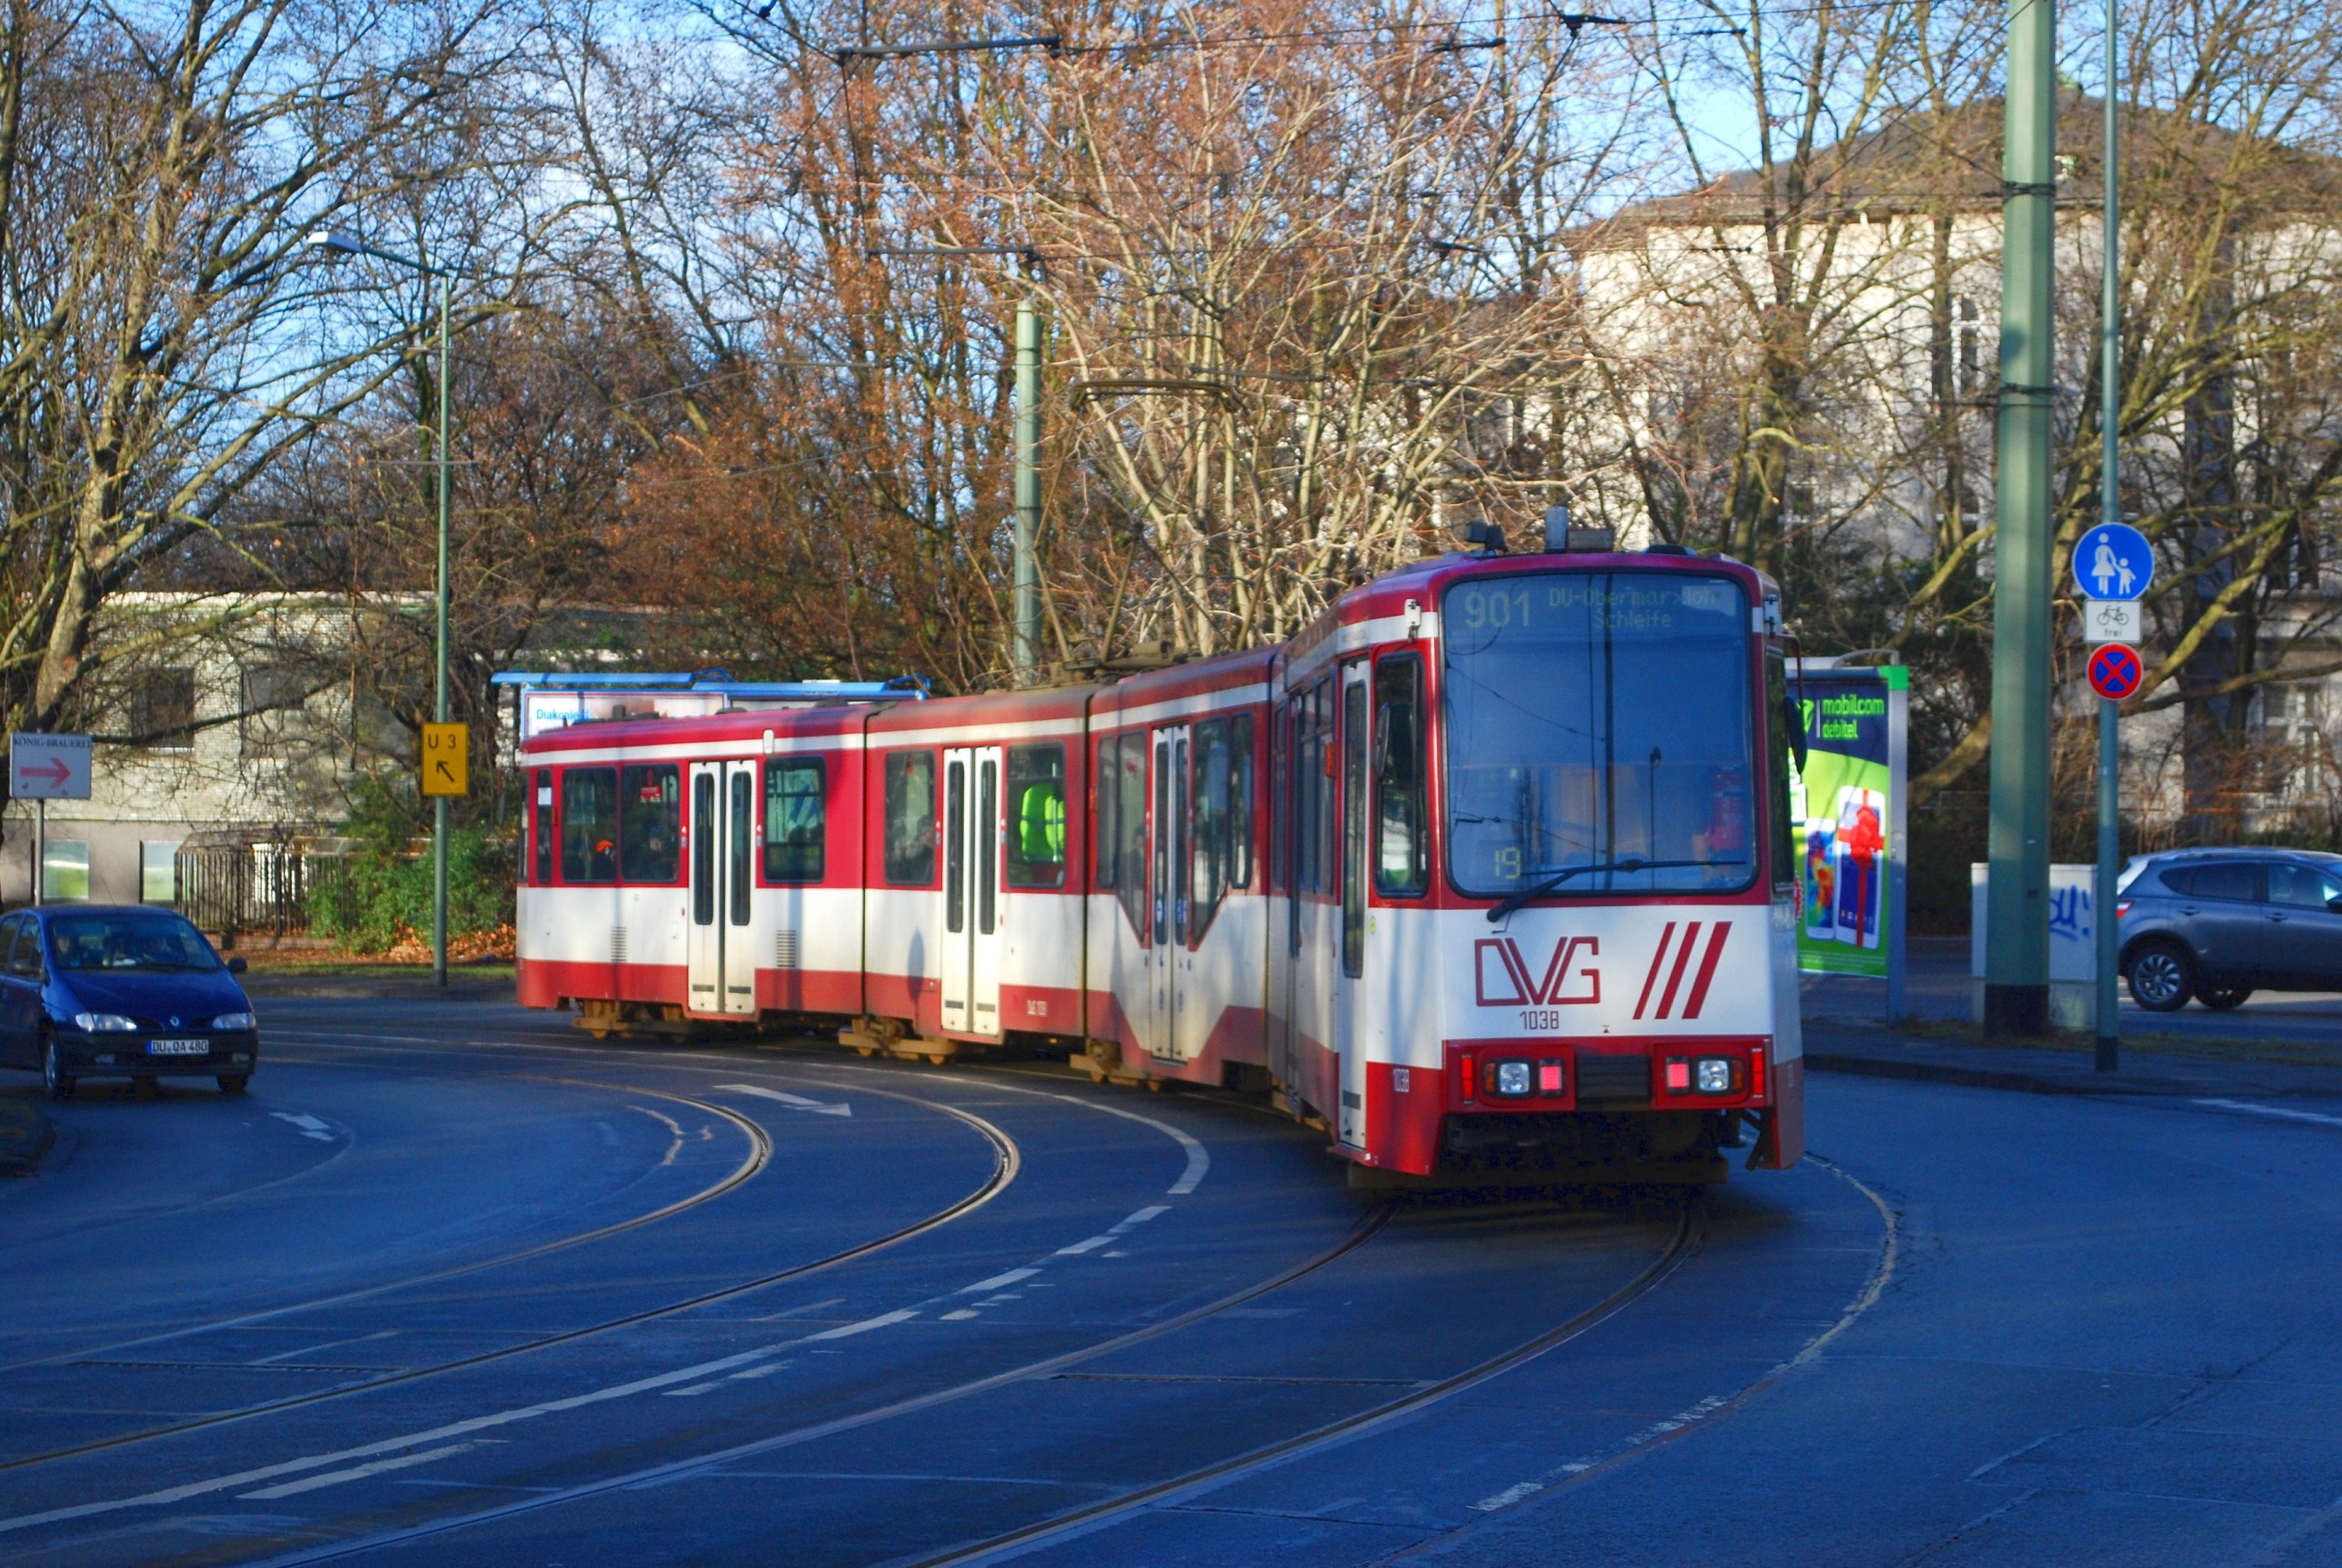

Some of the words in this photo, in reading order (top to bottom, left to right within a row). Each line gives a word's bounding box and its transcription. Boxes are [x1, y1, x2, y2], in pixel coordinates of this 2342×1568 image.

[1465, 591, 1530, 627] 901
[1594, 609, 1672, 628] Schleife
[2105, 628, 2122, 637] frei
[1822, 694, 1885, 715] mobilcom
[536, 709, 579, 720] Diakonie
[1822, 719, 1859, 738] debitel
[428, 734, 439, 748] U
[447, 734, 457, 748] 3
[1475, 936, 1600, 1006] DVG
[1519, 1011, 1560, 1030] 1038
[153, 1041, 167, 1052] DU
[173, 1041, 187, 1051] QA
